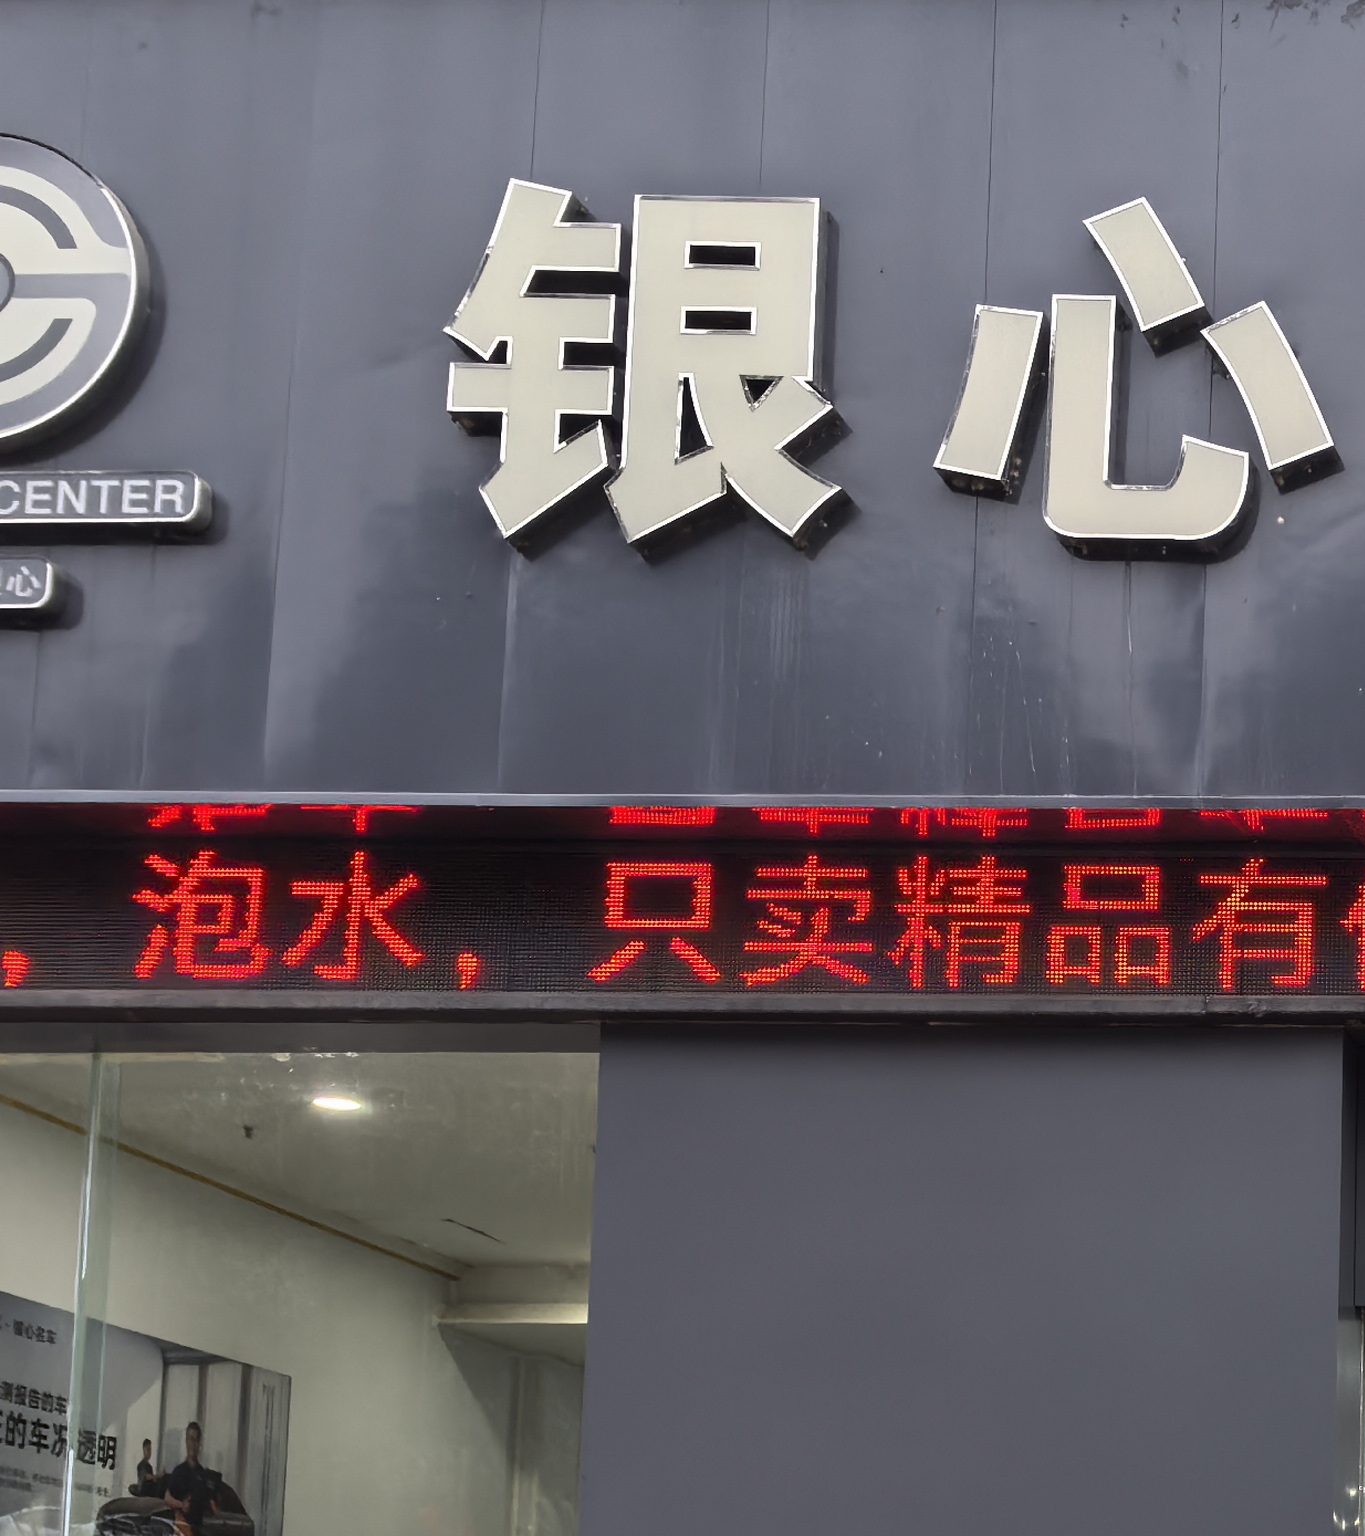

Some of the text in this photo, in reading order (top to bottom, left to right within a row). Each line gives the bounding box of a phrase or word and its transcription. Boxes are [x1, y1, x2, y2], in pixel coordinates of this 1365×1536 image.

[0, 479, 186, 515] CENTER
[0, 565, 42, 597] 心
[0, 1409, 117, 1471] 的车况透明
